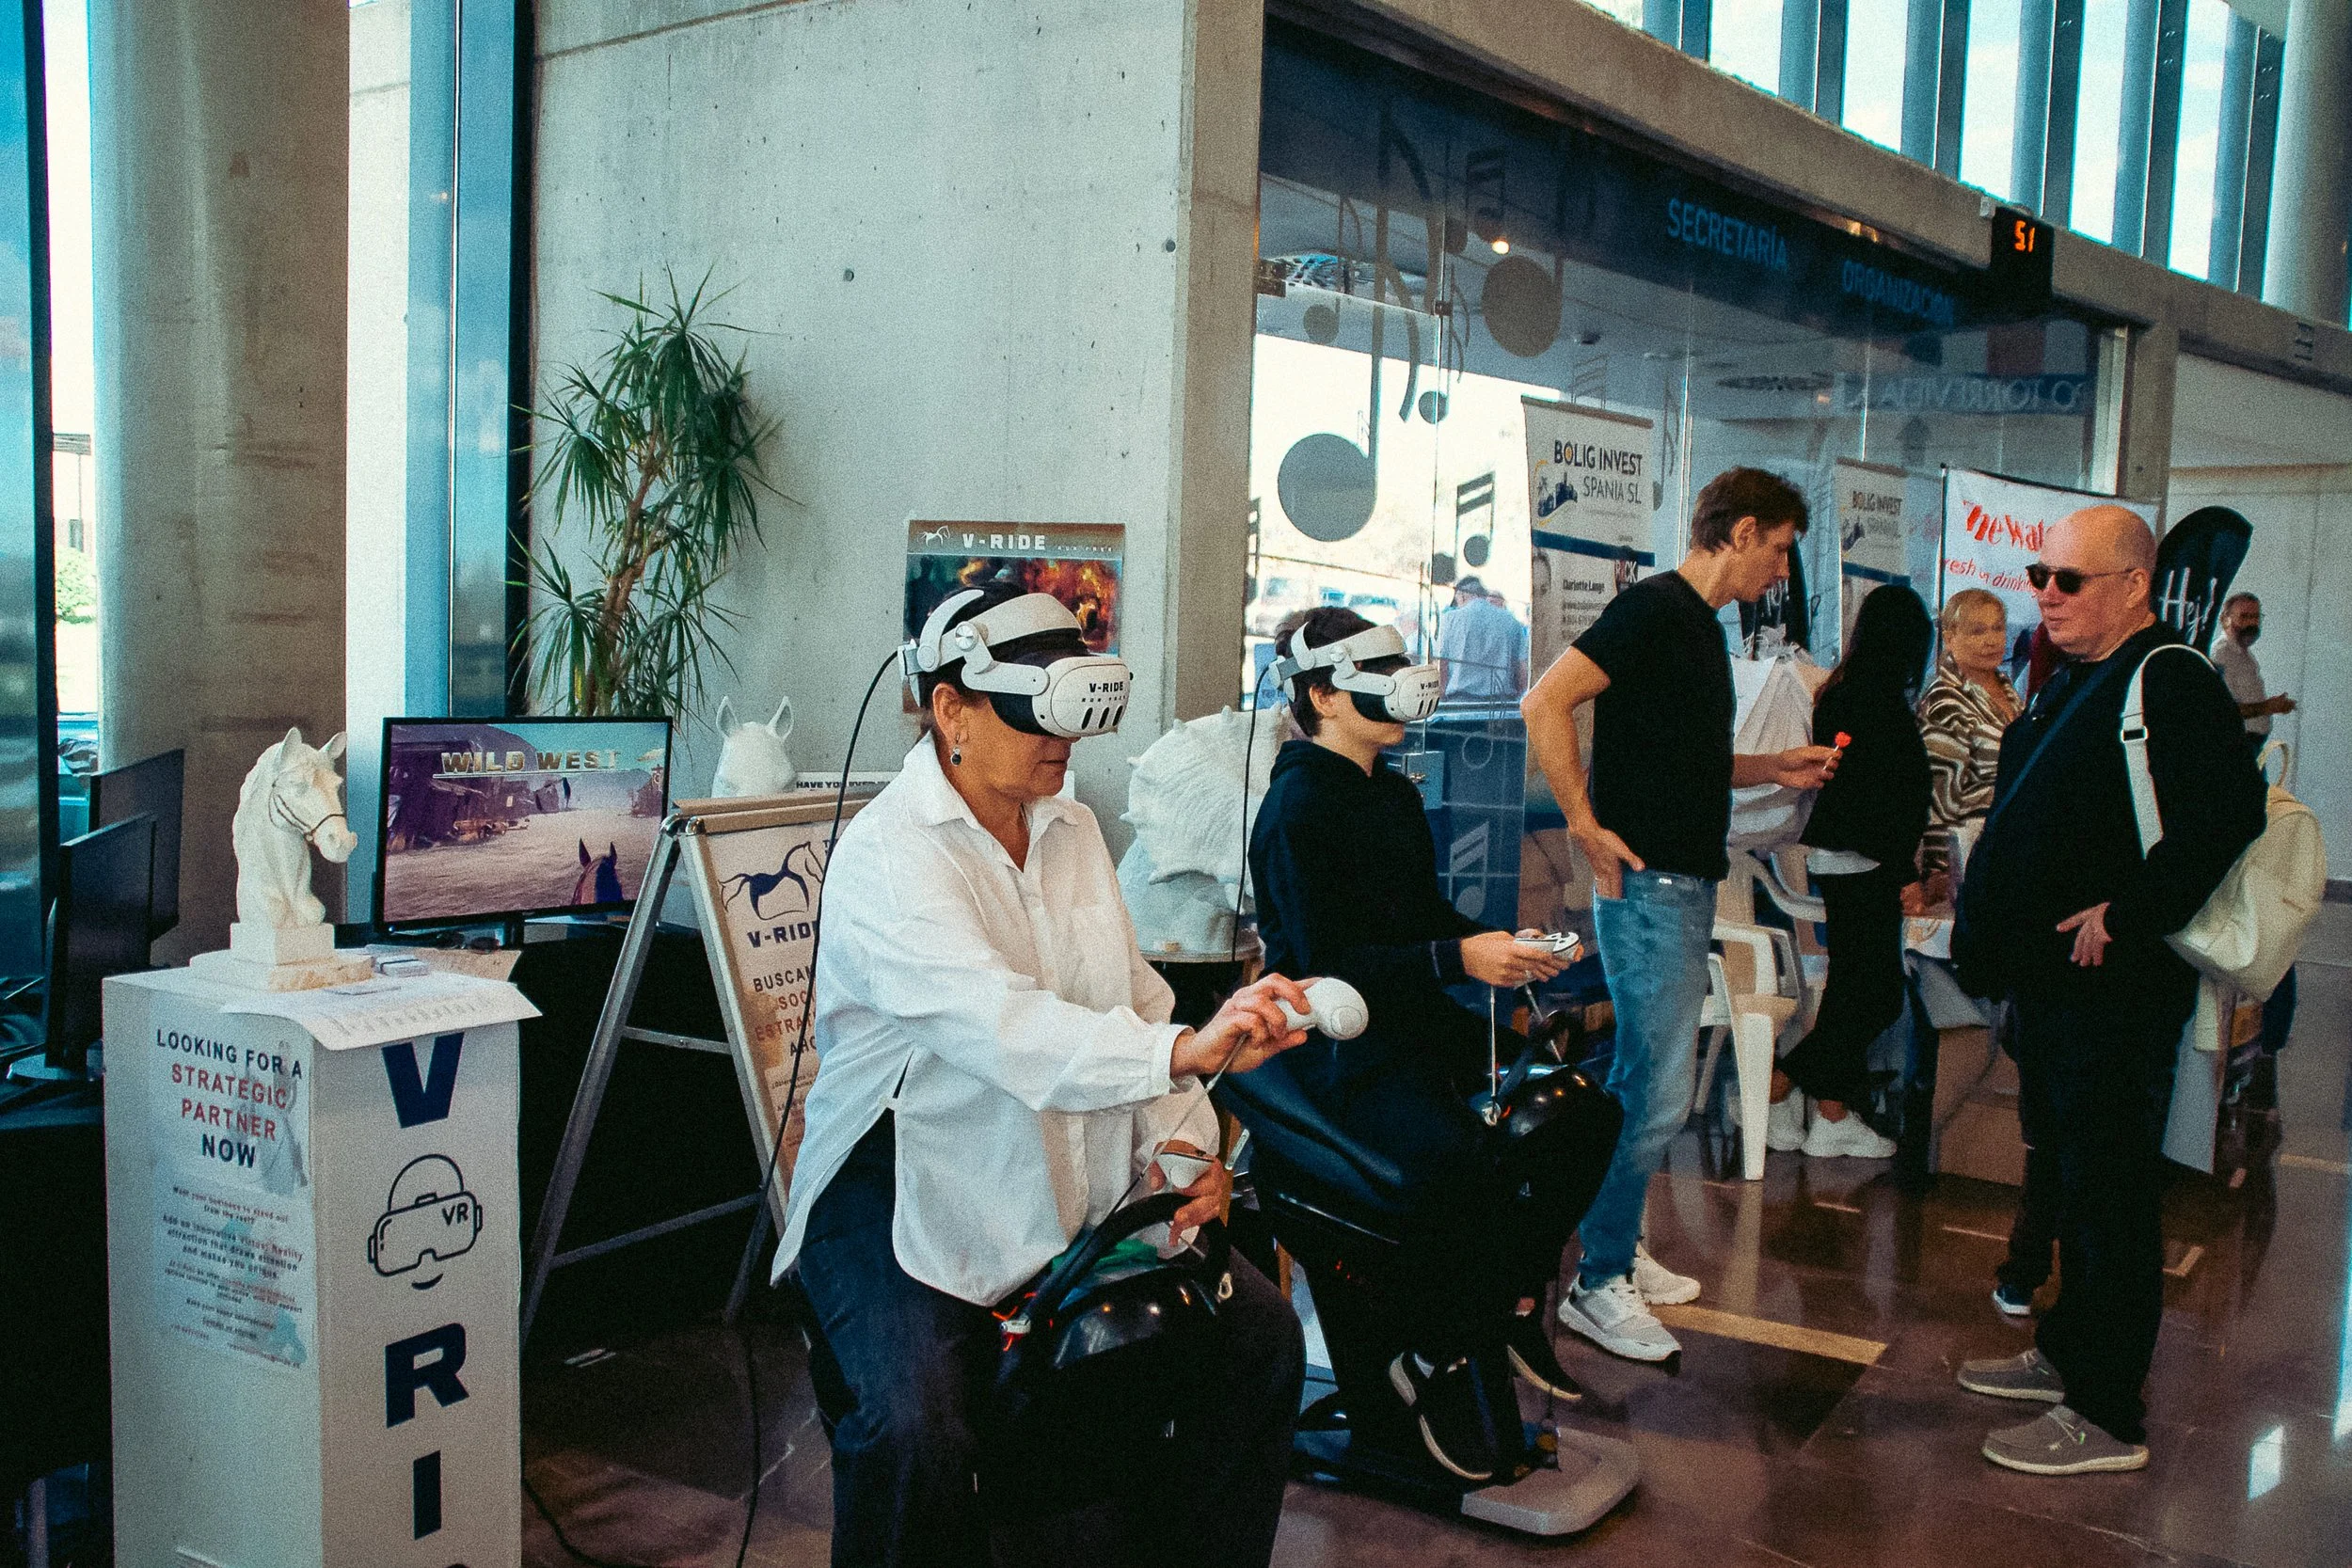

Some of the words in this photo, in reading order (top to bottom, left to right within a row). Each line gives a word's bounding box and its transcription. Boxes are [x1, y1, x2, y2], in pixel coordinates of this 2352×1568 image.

[1667, 197, 1788, 274] SECRETARÍA
[1554, 440, 1596, 469] BOLIG
[1599, 447, 1643, 476] INVEST
[1582, 475, 1624, 501] SPANIA
[1627, 482, 1642, 504] SL
[961, 532, 1046, 551] V-RIDE
[1942, 558, 1976, 576] resh
[1089, 681, 1123, 693] V-RIDE
[440, 751, 525, 774] WILD
[536, 750, 622, 770] WEST
[796, 781, 823, 789] HAVE
[755, 1011, 817, 1041] ESTRAT
[156, 1028, 238, 1064] LOOKING
[246, 1048, 283, 1074] FOR
[291, 1059, 303, 1079] A
[171, 1063, 288, 1109] STRATEGIC
[181, 1099, 277, 1141] PARTNER
[201, 1133, 256, 1169] NOW
[441, 1205, 469, 1227] VR
